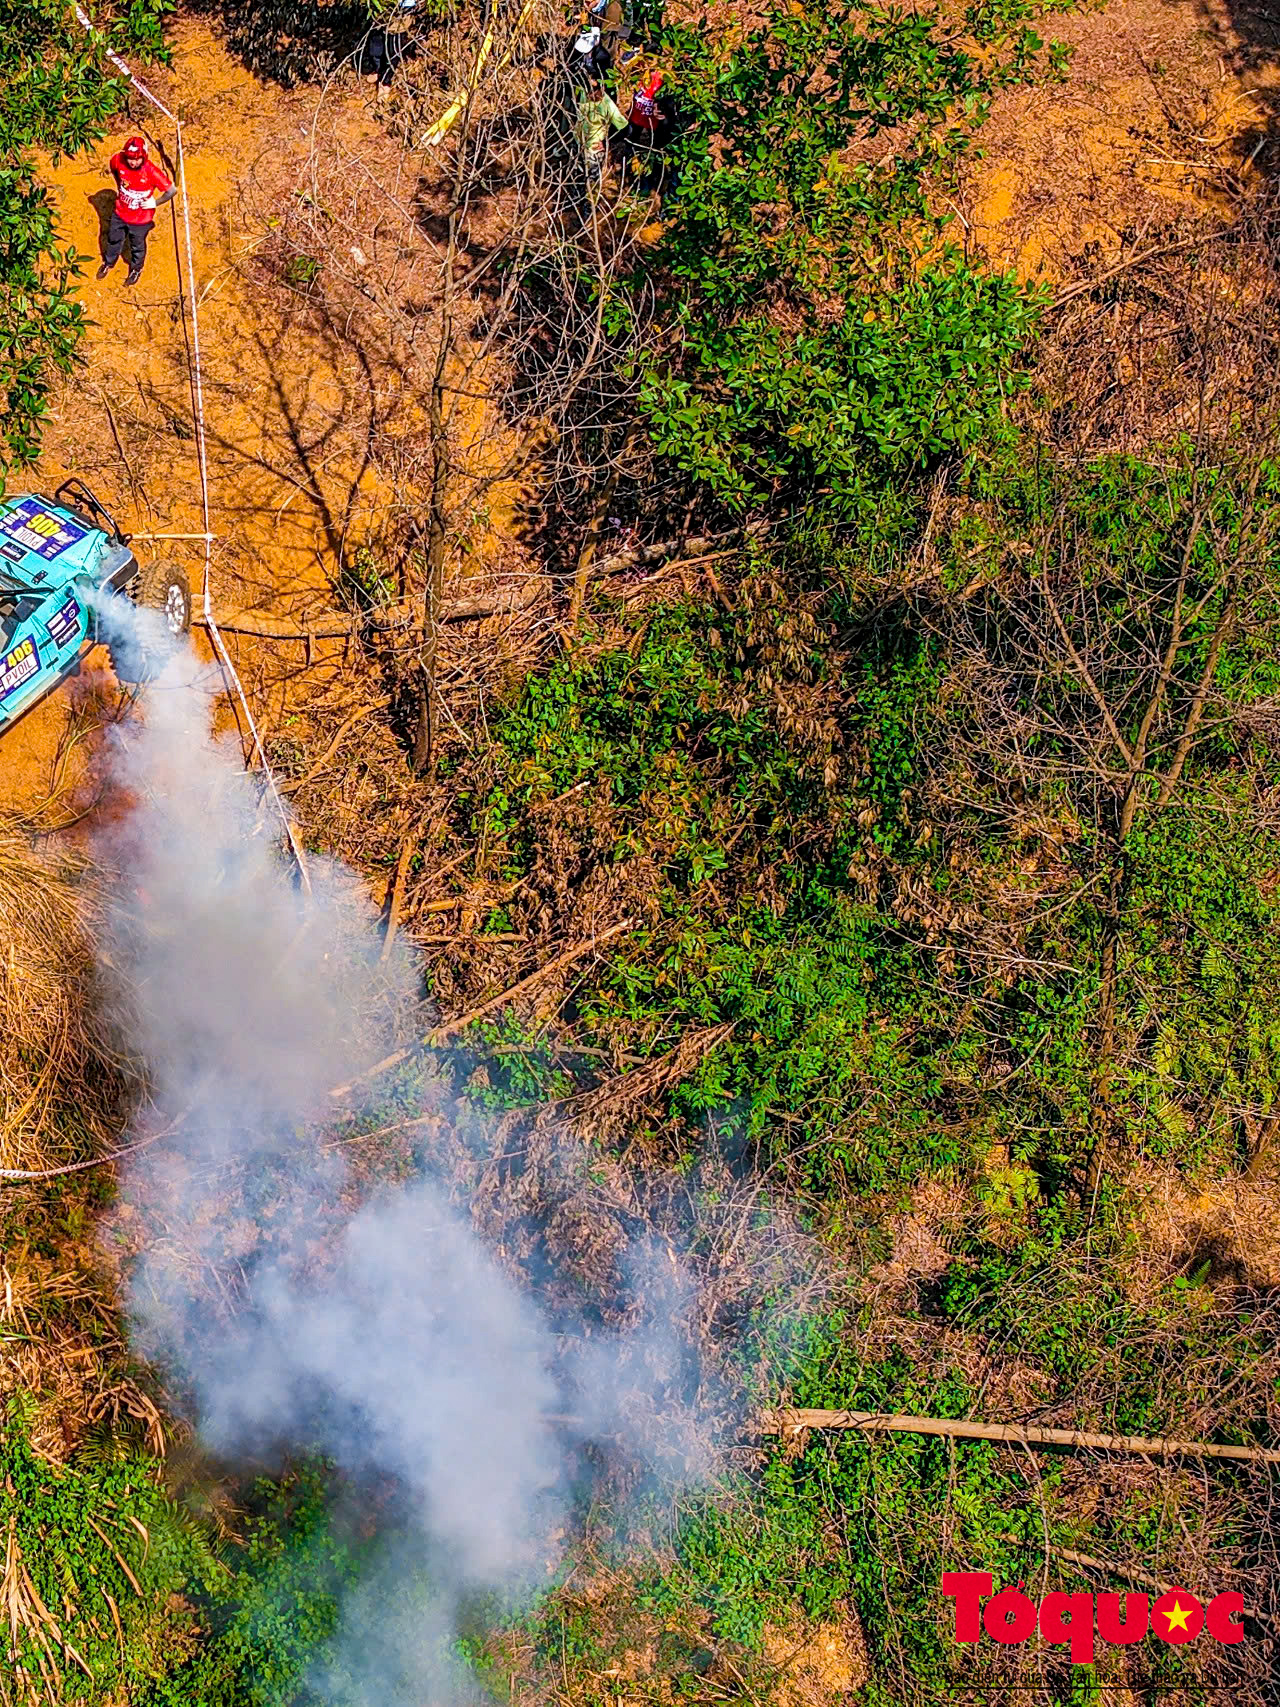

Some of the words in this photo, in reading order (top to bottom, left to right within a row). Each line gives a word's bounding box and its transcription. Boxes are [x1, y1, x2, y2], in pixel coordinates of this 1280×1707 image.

[16, 528, 42, 548] PVOIL
[26, 514, 61, 538] 406
[7, 639, 33, 667] 406
[5, 659, 32, 685] PVOIL
